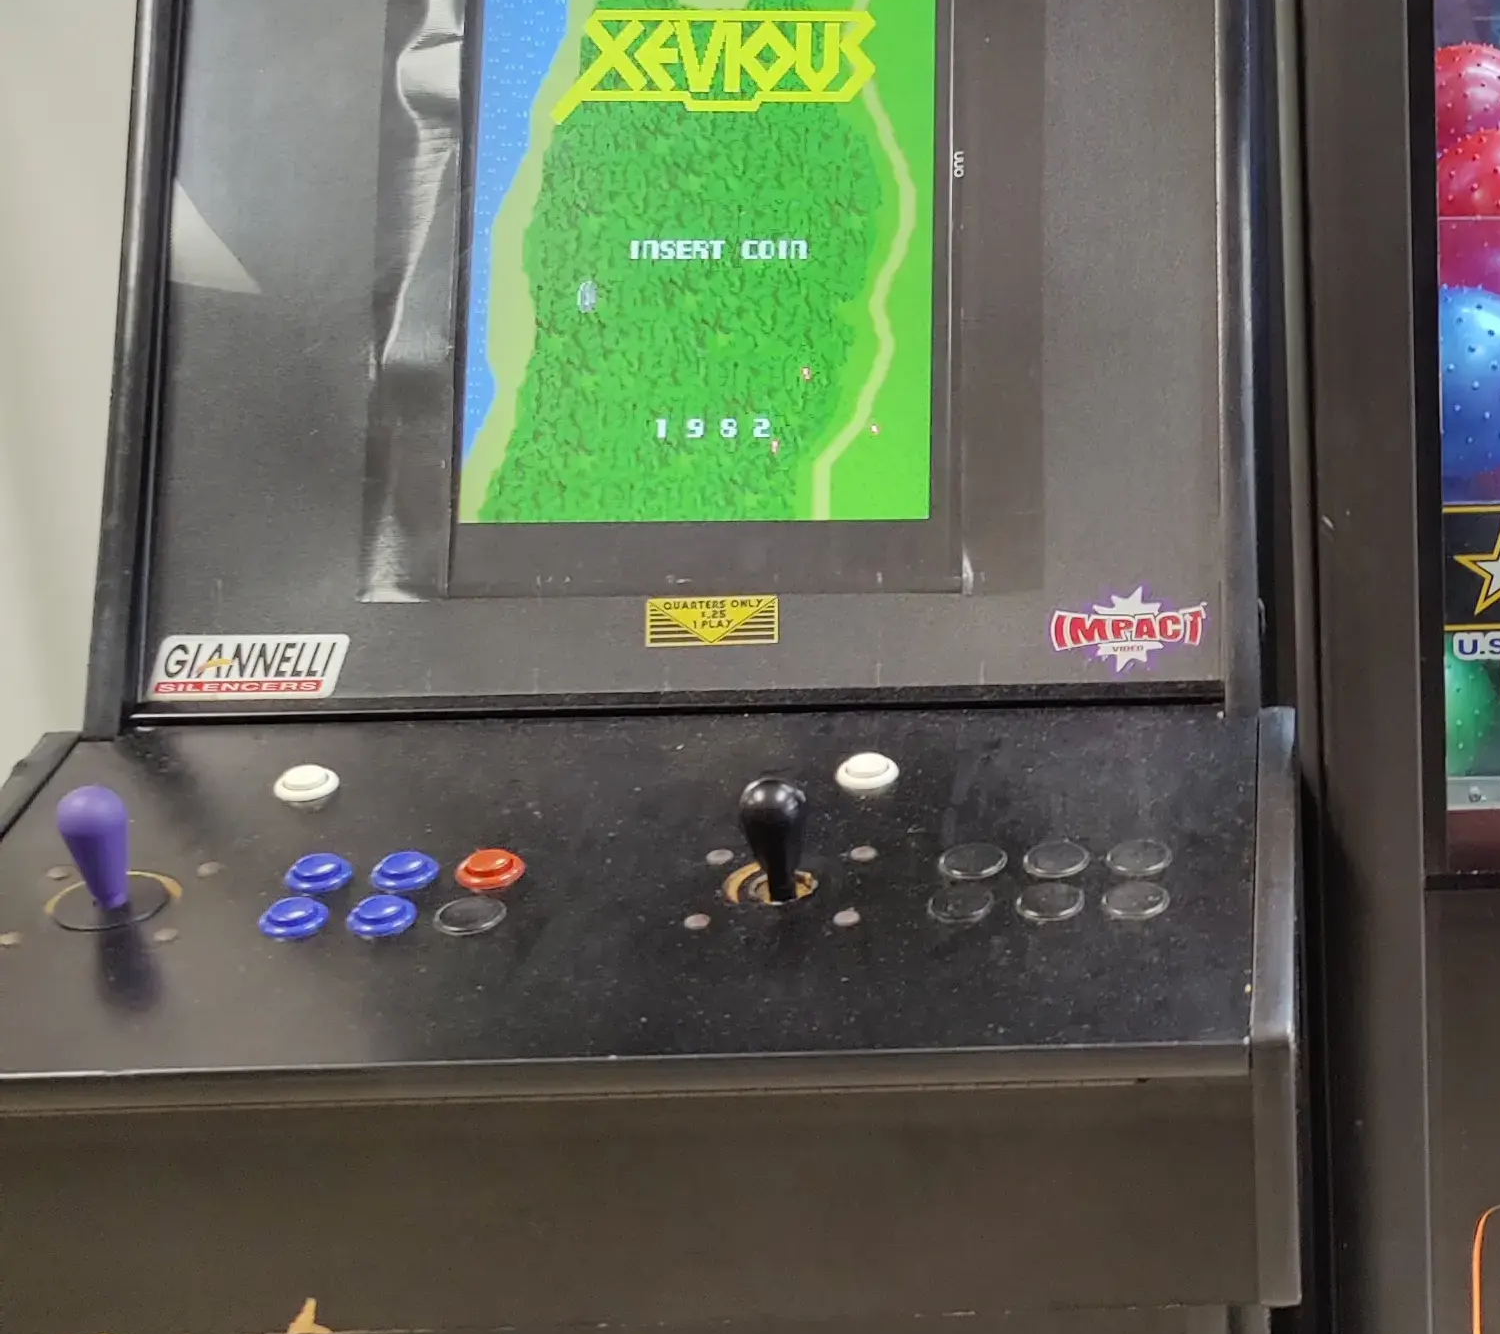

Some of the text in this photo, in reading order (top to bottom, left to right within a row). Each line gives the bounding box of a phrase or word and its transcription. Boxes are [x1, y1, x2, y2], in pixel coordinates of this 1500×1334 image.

[550, 9, 876, 123] XEVIOUS
[630, 239, 809, 260] INSERT COIN
[663, 598, 763, 610] QUARTERS ONLY
[701, 619, 734, 629] PLAY
[1052, 604, 1206, 650] IMPACT
[164, 641, 337, 680] GIANNELLI
[154, 680, 321, 694] SILENCERS
